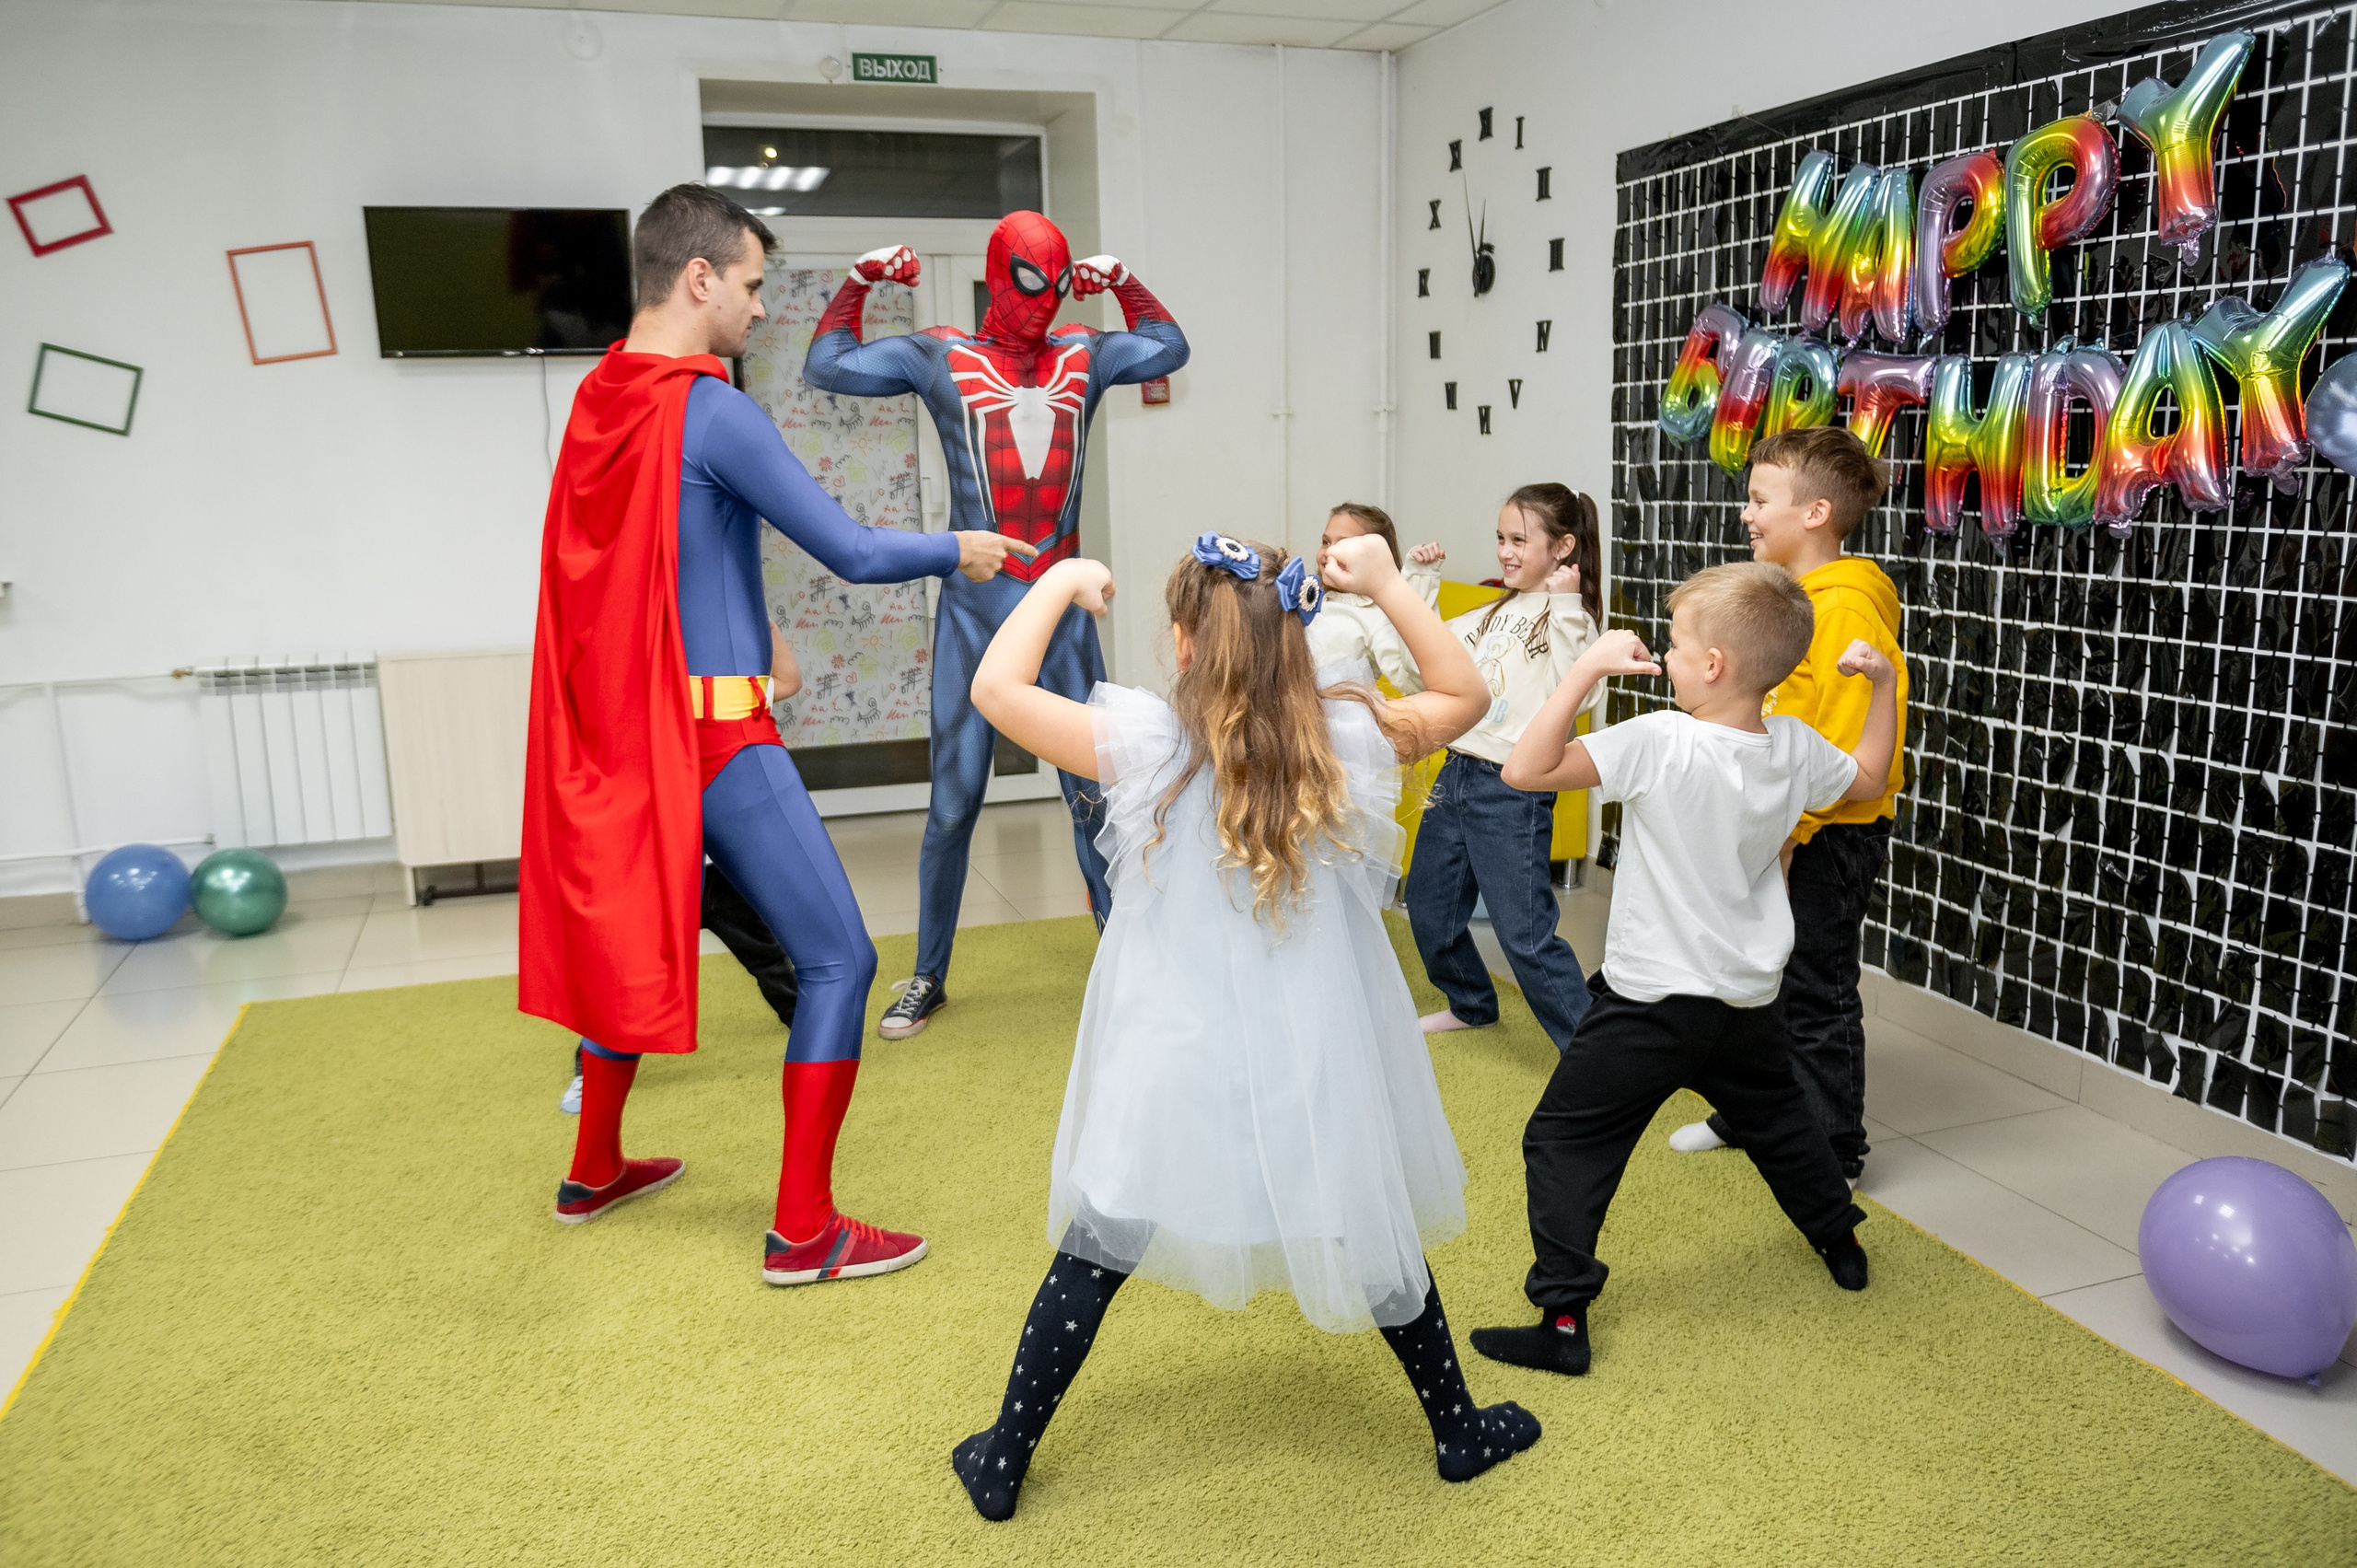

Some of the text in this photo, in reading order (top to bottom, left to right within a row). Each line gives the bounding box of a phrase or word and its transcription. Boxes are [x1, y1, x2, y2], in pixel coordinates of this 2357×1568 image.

[859, 58, 931, 80] ВЫХОД
[1759, 29, 2256, 347] HAPPY
[1658, 258, 2352, 547] BIRTHDAY
[1510, 616, 1549, 659] BEAR
